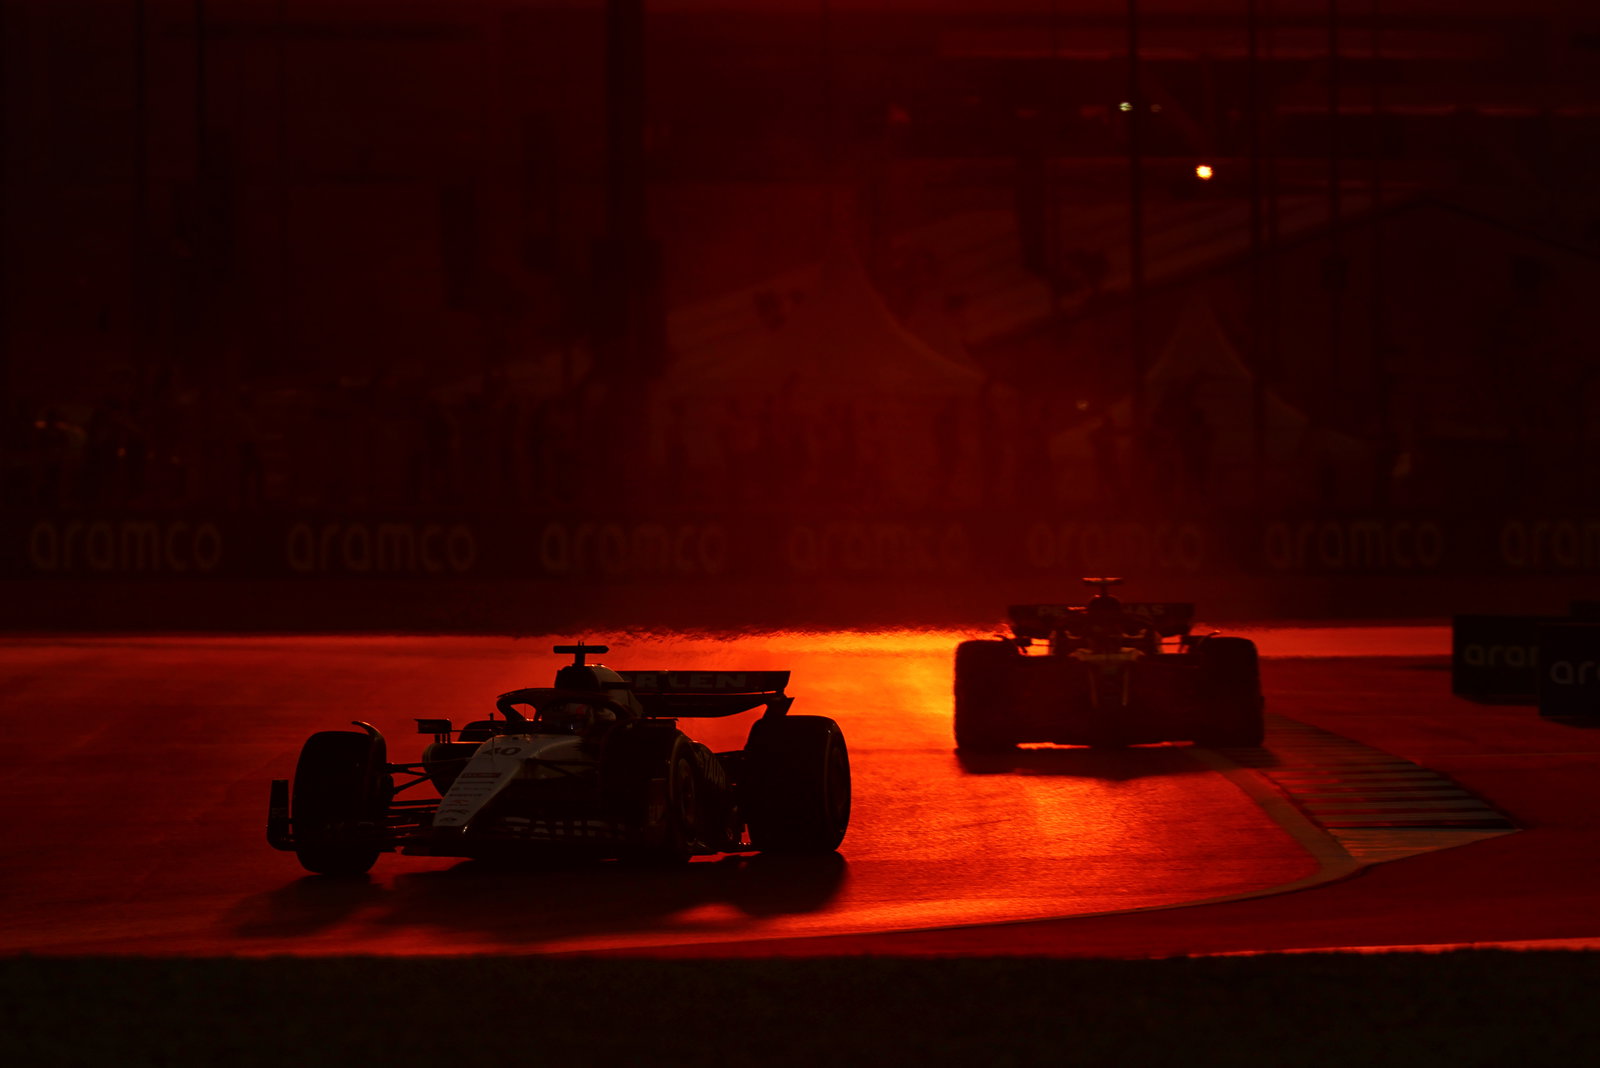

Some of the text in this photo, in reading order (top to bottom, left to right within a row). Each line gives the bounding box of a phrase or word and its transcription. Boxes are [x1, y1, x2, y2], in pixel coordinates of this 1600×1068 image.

[30, 521, 222, 572] aramco
[286, 521, 477, 572] aramco
[540, 521, 726, 574] aramco
[788, 521, 967, 573] aramco
[1025, 520, 1206, 571] aramco
[1264, 520, 1444, 570] aramco
[1549, 660, 1600, 685] ar
